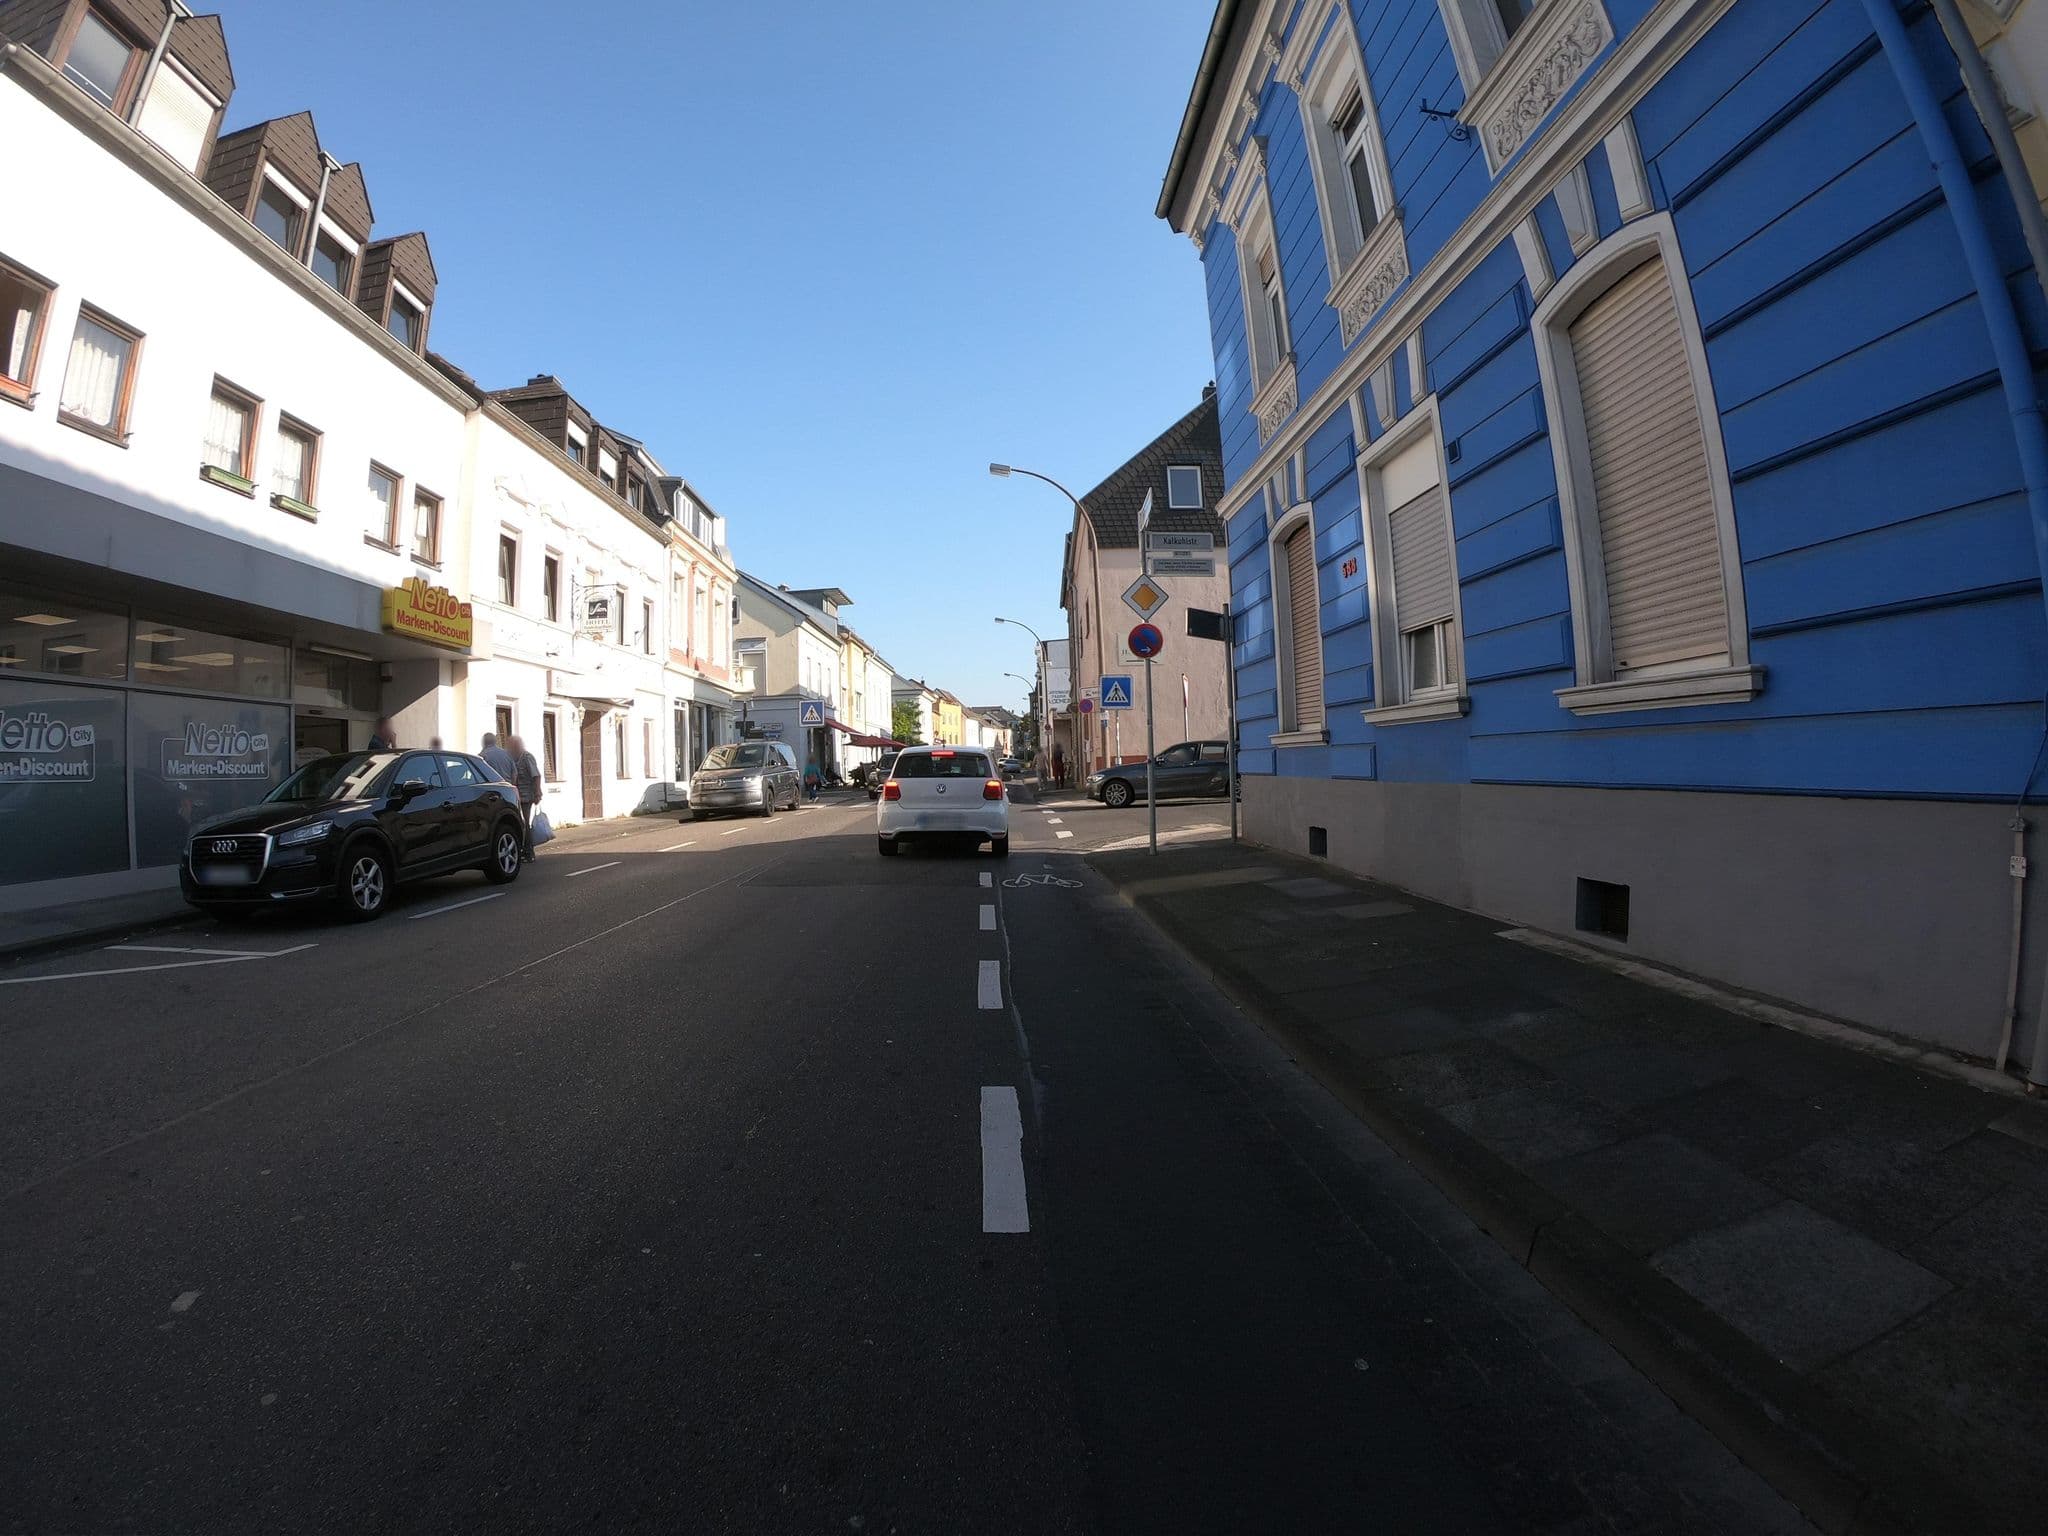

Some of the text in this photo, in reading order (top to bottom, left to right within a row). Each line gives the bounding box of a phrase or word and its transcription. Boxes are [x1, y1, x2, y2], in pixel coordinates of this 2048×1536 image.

[410, 577, 459, 620] Netto
[396, 609, 470, 641] Marken-Discount
[0, 711, 92, 751] etto City
[185, 722, 266, 754] Netto City
[167, 759, 267, 775] Marken-Discount
